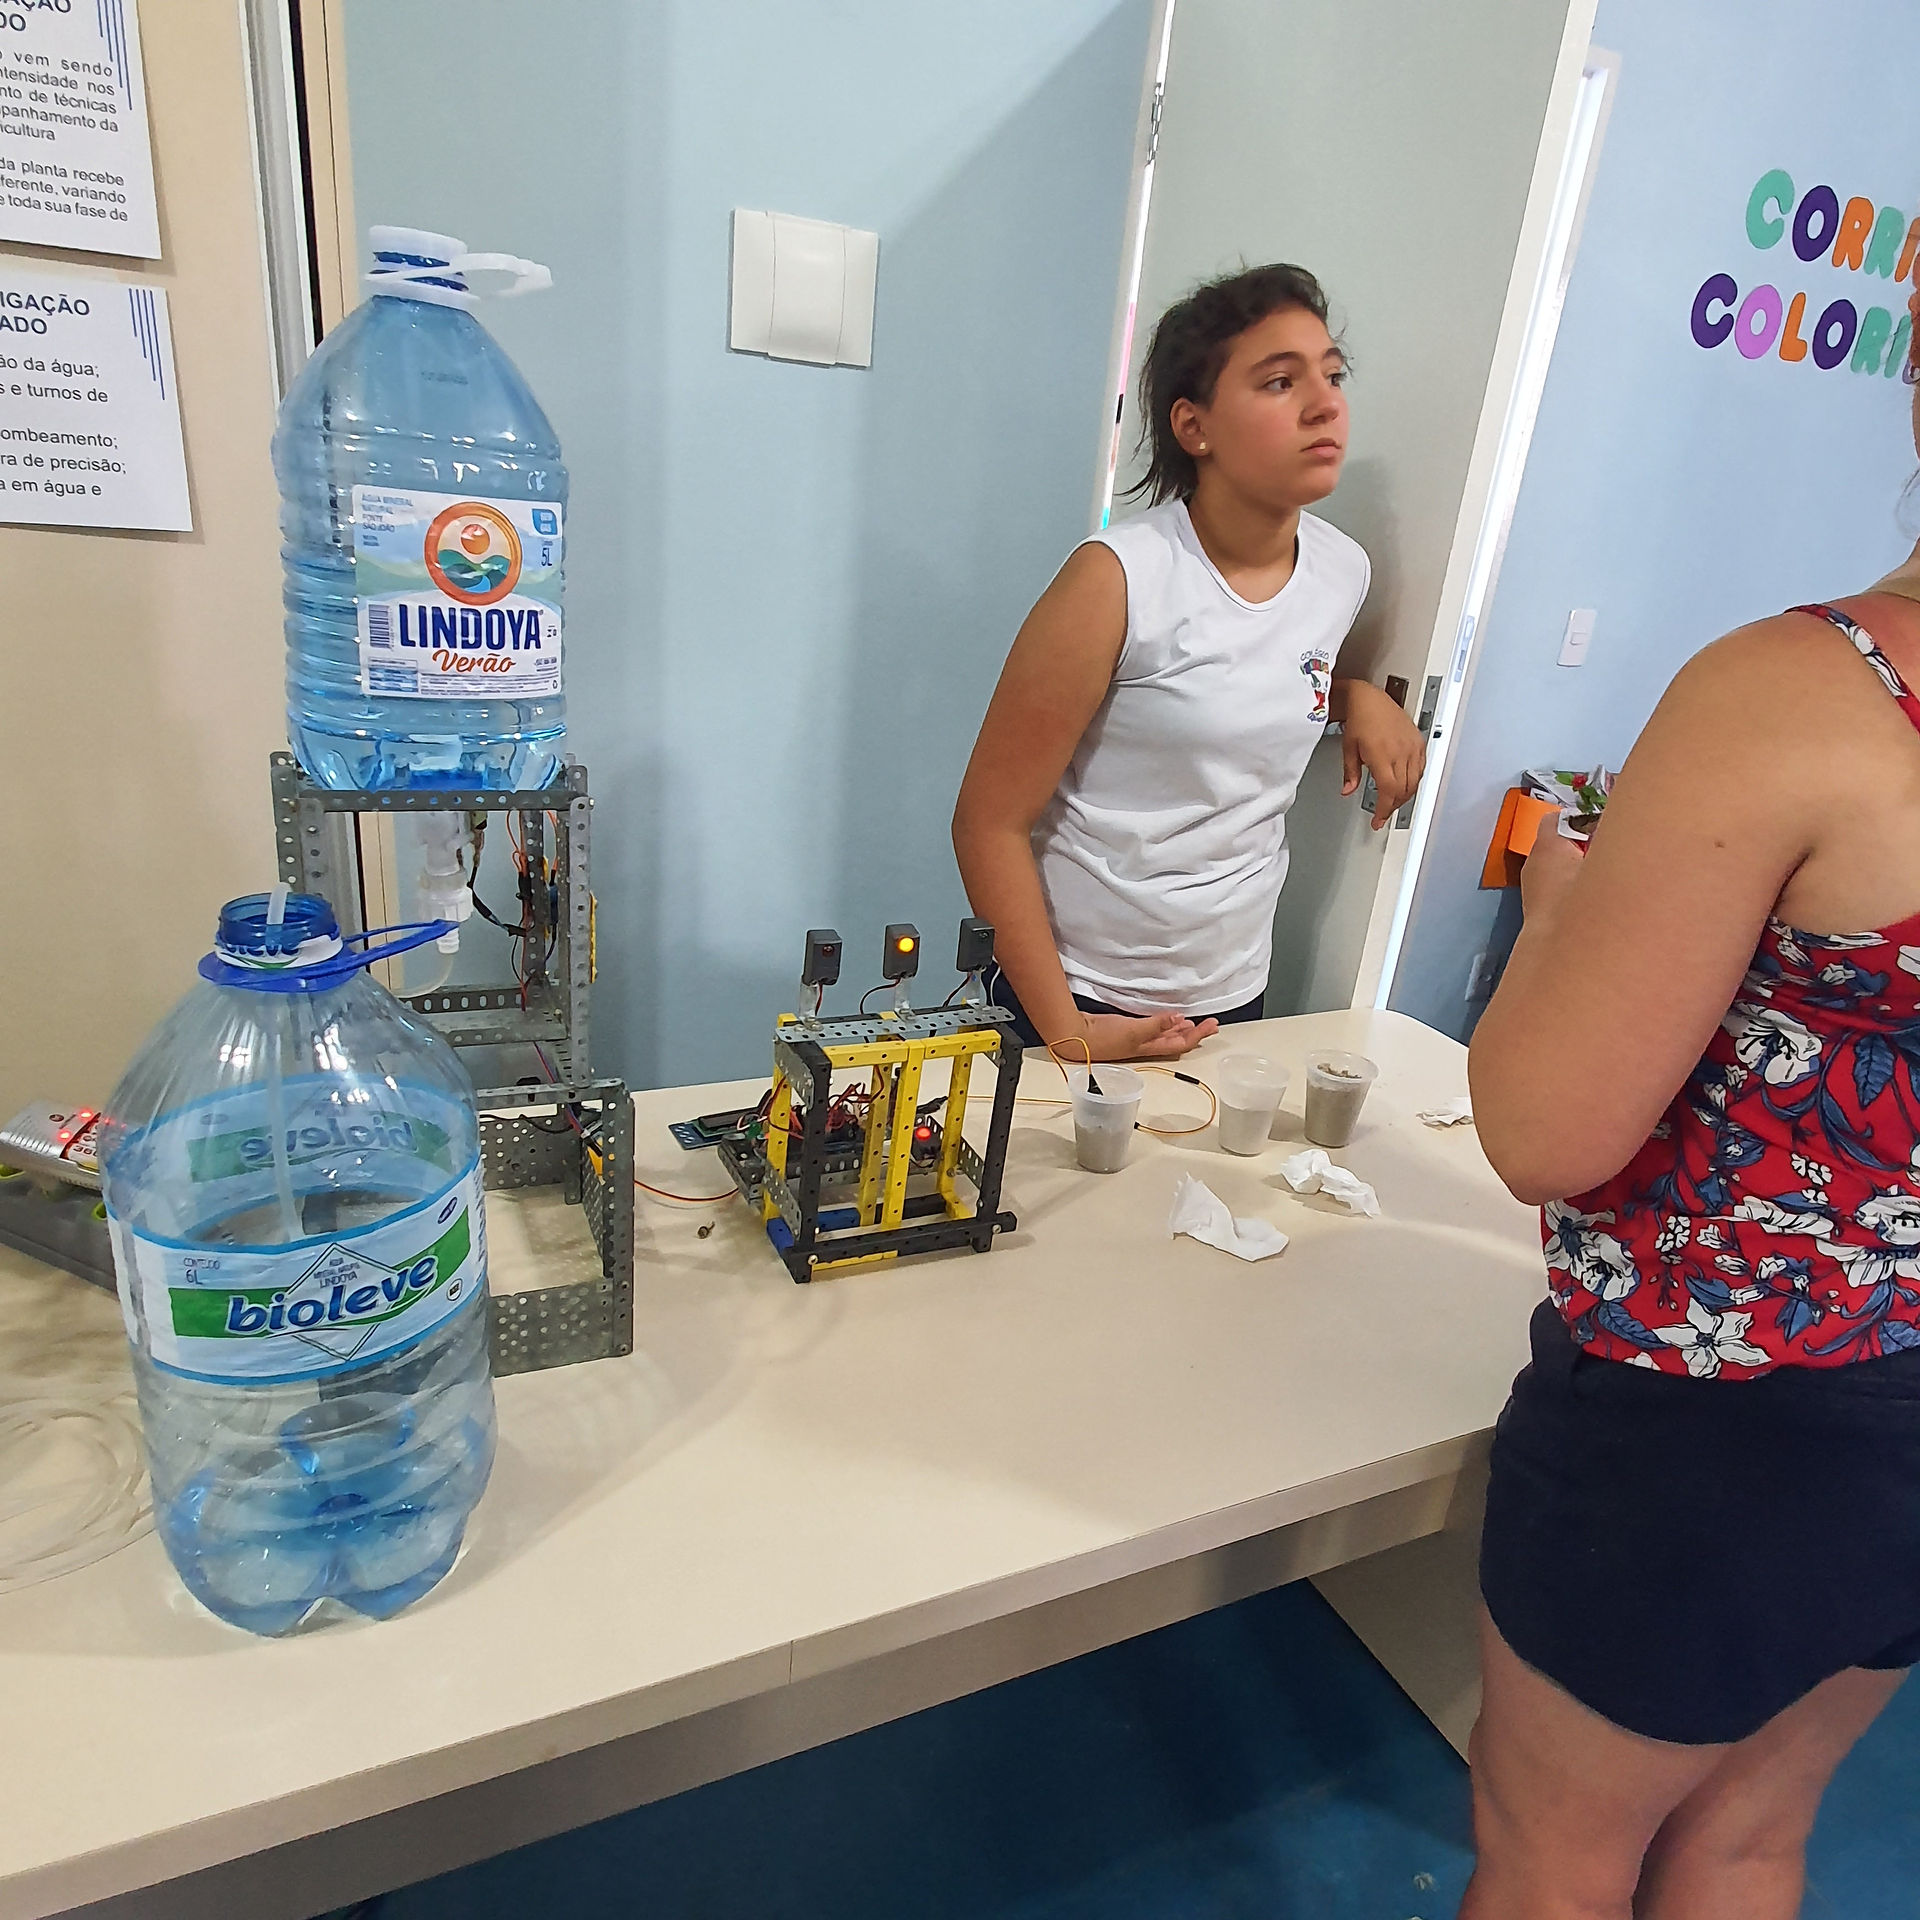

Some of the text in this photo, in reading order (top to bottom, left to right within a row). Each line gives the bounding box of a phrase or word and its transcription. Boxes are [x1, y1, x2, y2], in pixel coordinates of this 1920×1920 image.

[14, 52, 112, 77] vem sendo
[88, 81, 115, 96] nos
[29, 90, 48, 103] de
[54, 92, 117, 114] técnicas
[0, 105, 118, 132] panhamento da
[22, 160, 67, 178] planta
[73, 170, 124, 186] recebe
[62, 186, 126, 204] variando
[8, 194, 41, 210] toda
[45, 200, 71, 213] sua
[75, 202, 106, 218] fase
[110, 208, 128, 221] de
[0, 291, 90, 316] IGAÇÃO
[0, 315, 47, 335] ADO
[1690, 273, 1920, 386] COLORI
[0, 354, 100, 378] ão da água;
[11, 384, 22, 395] e
[27, 383, 82, 400] turnos
[87, 388, 108, 402] de
[0, 428, 118, 450] ombeamento;
[0, 453, 126, 474] ra de precisão;
[11, 480, 38, 492] em
[44, 479, 86, 497] água
[91, 485, 102, 496] e
[541, 547, 553, 567] 5L
[399, 604, 541, 650] LINDOYA
[432, 649, 516, 673] Verão
[186, 1269, 203, 1285] 6L
[228, 1256, 436, 1333] bioleve
